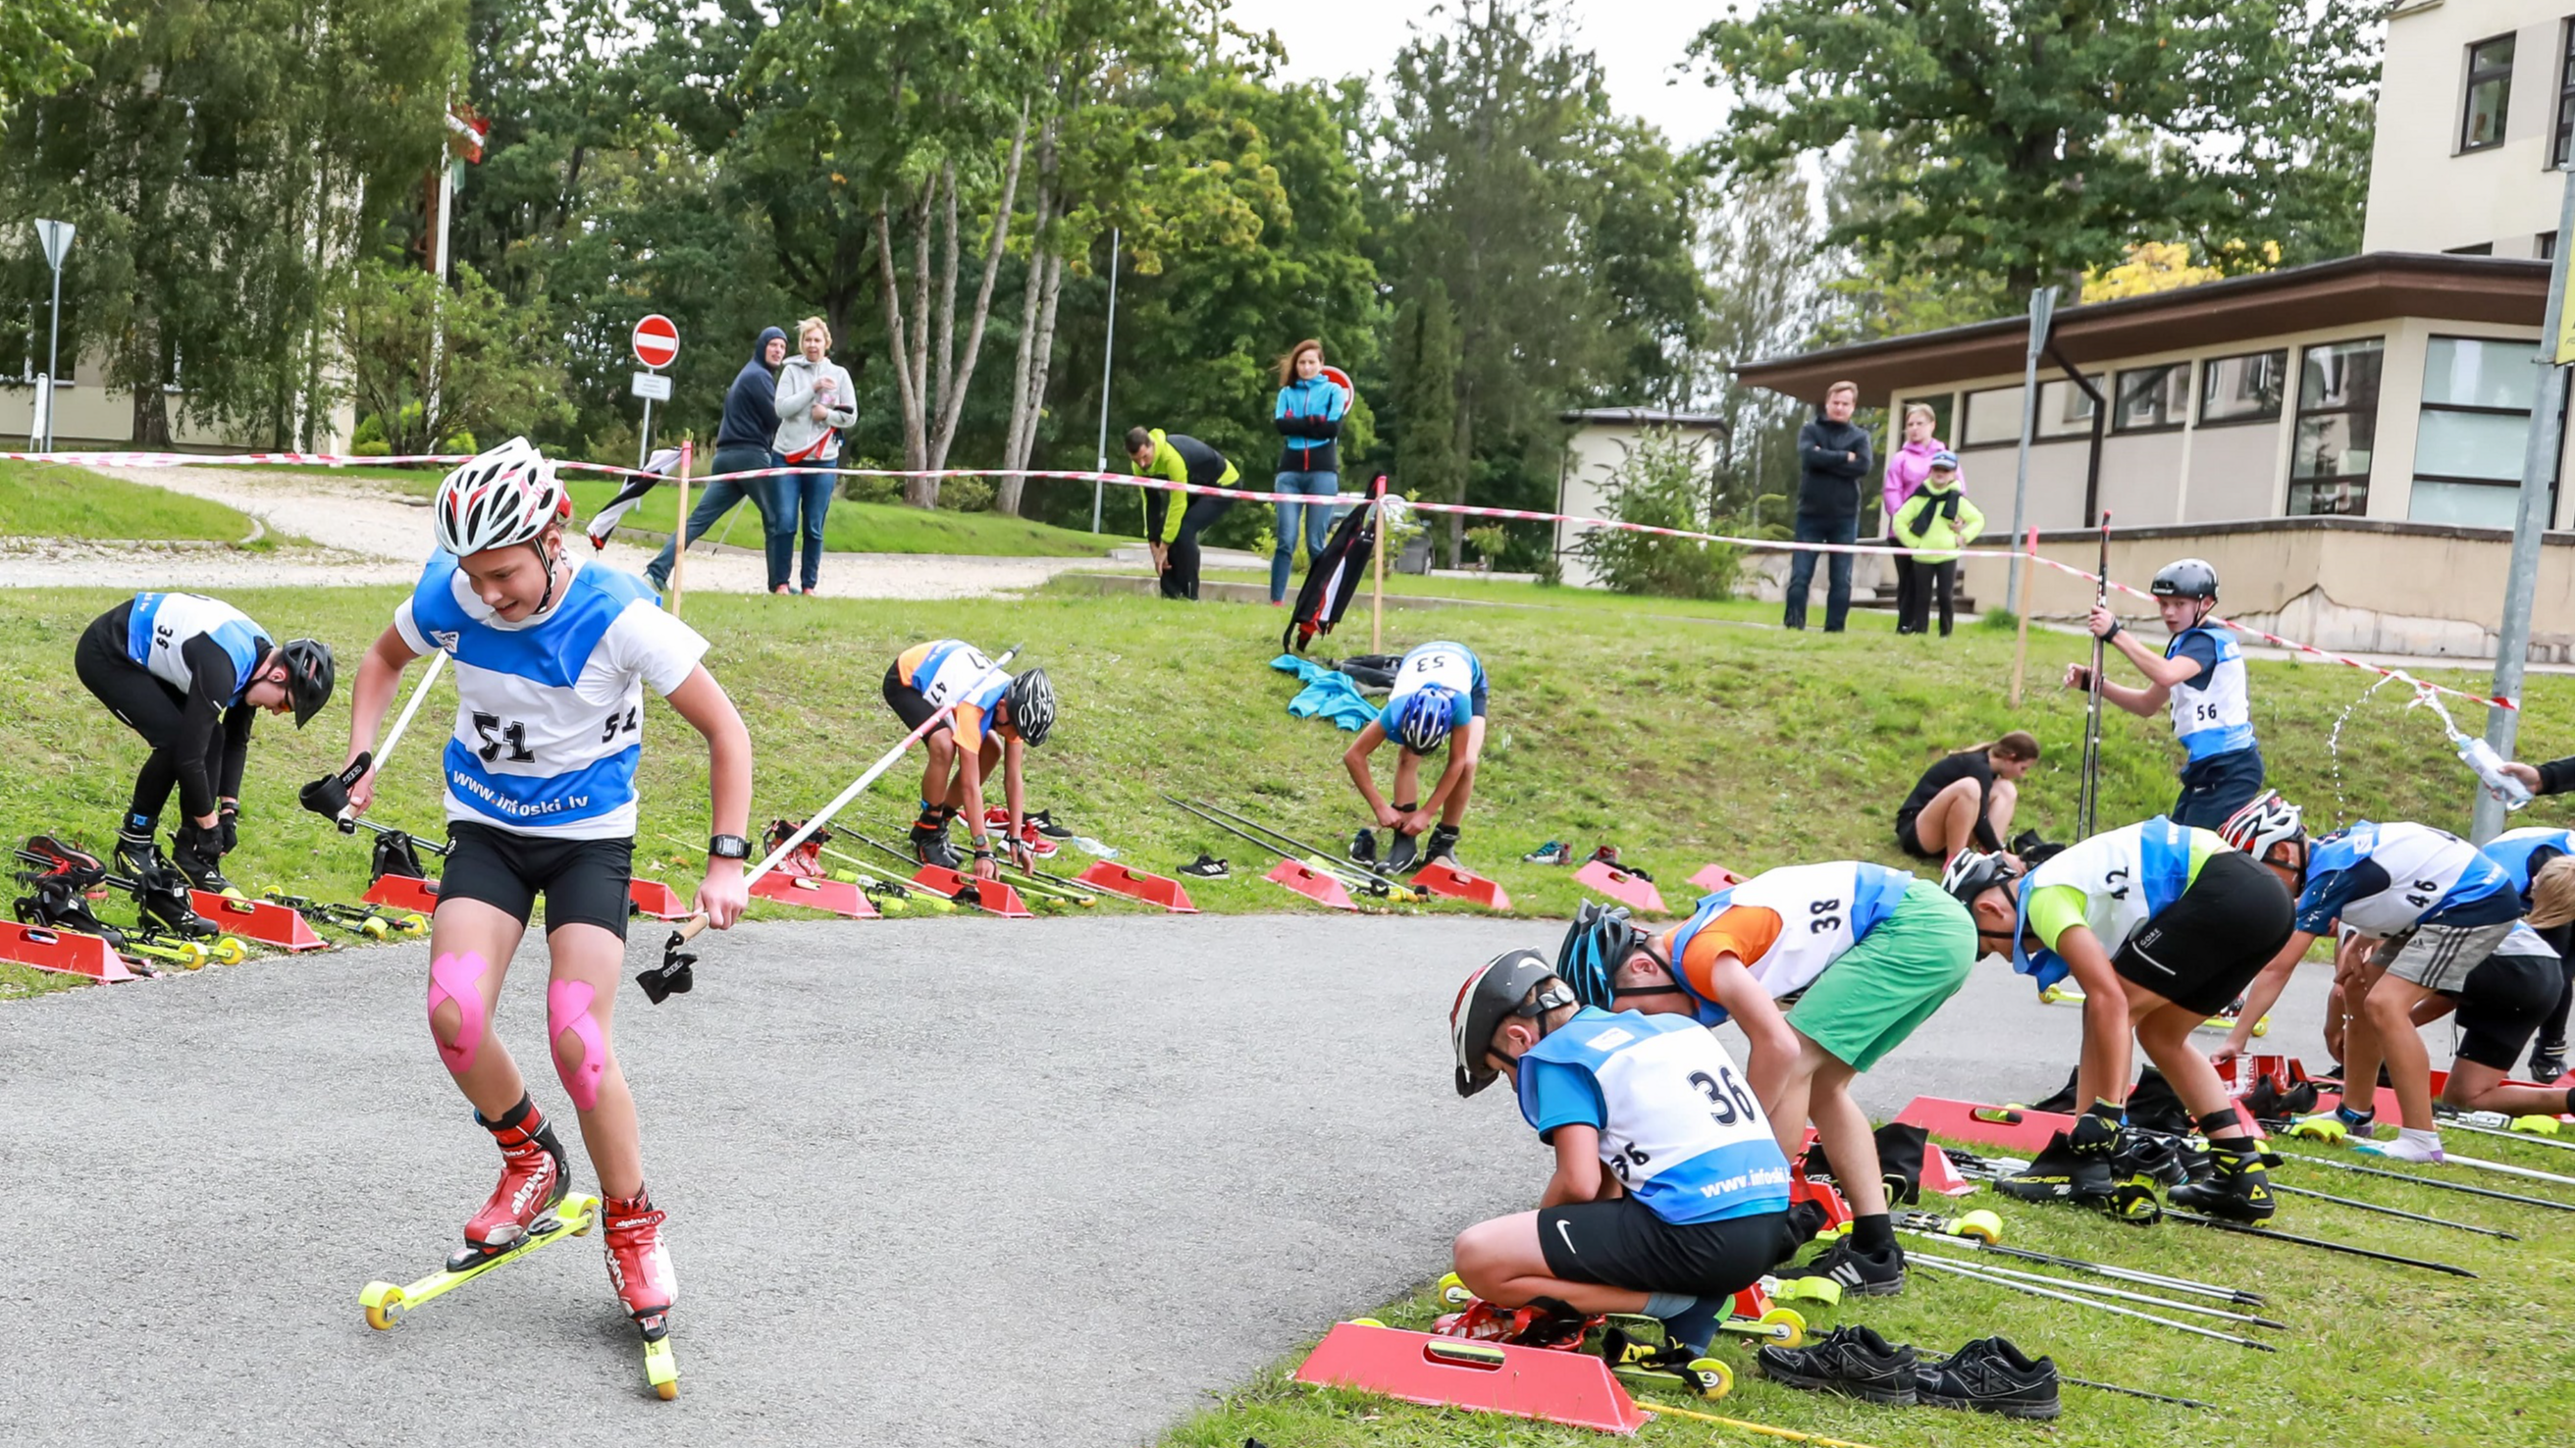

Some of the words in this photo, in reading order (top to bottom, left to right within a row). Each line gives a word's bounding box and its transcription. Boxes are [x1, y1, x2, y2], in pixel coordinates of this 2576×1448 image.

[1417, 655, 1446, 673] 53
[930, 682, 948, 704] 47
[602, 705, 637, 744] 51
[2197, 704, 2217, 721] 56
[472, 710, 535, 763] 51
[2105, 865, 2129, 901] 42
[2405, 880, 2438, 908] 46
[1810, 899, 1842, 935] 38
[1686, 1064, 1757, 1127] 36
[1610, 1142, 1651, 1182] 36
